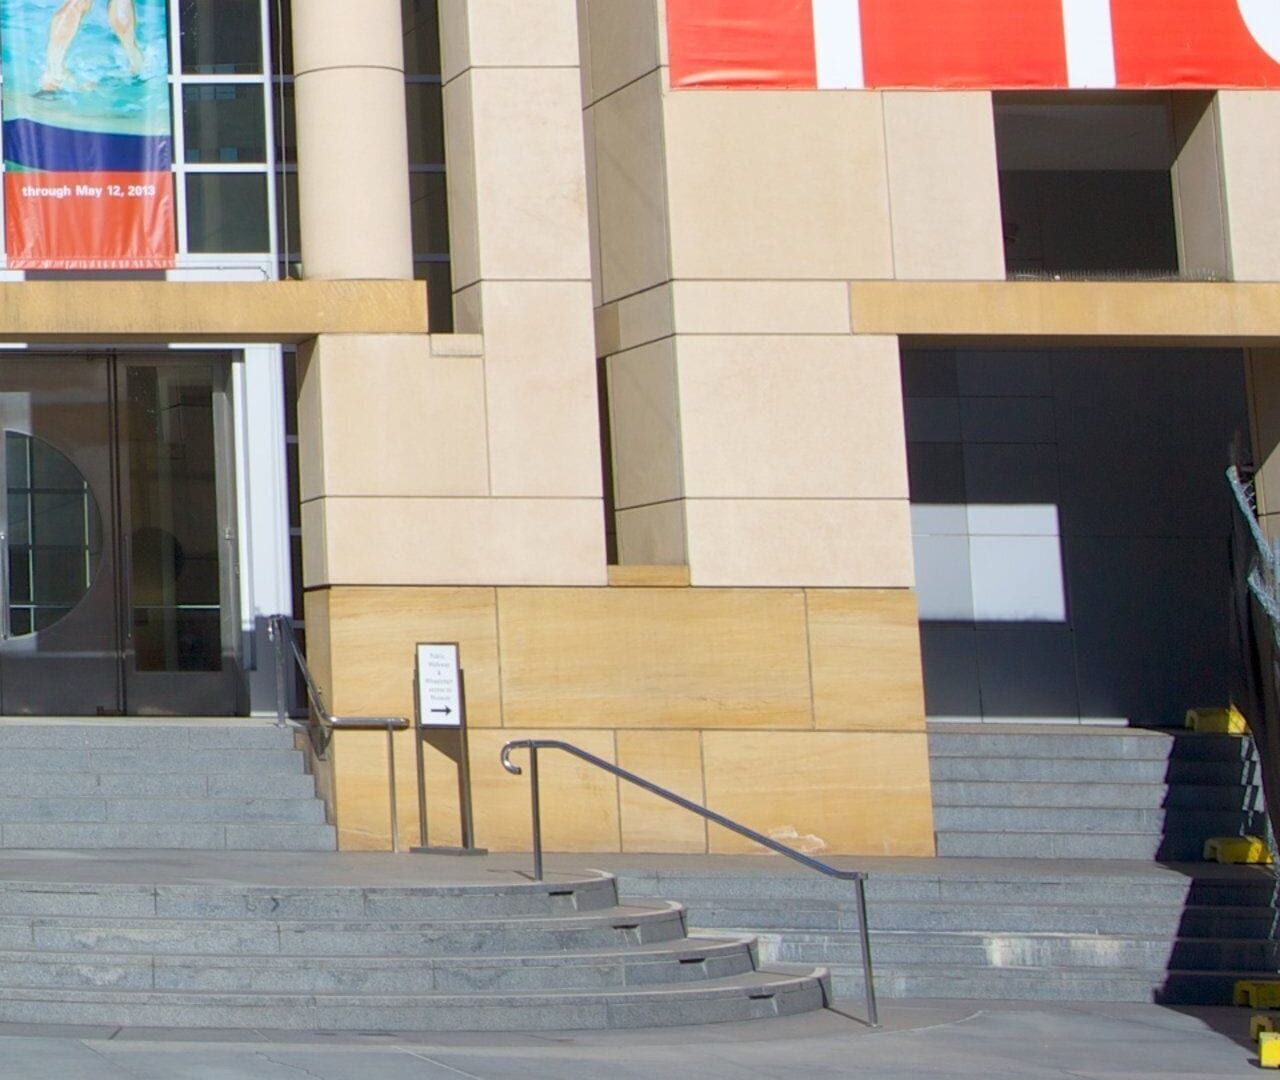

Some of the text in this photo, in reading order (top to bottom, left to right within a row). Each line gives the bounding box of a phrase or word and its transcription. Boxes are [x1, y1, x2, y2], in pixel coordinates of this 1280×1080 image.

[22, 185, 156, 199] through May 12, 2013
